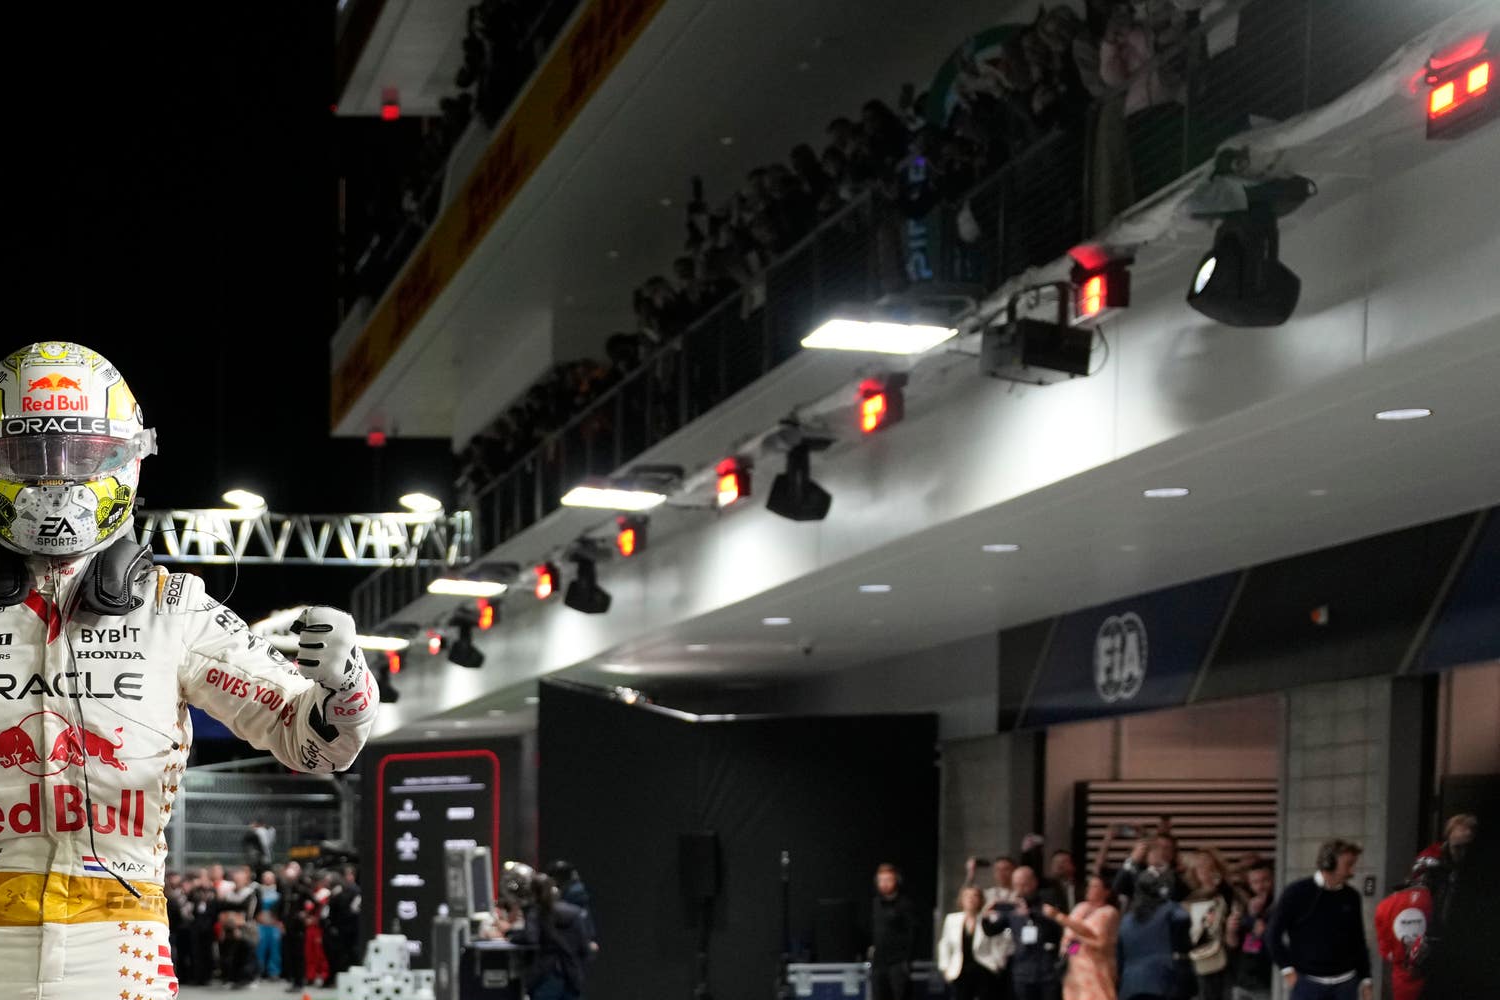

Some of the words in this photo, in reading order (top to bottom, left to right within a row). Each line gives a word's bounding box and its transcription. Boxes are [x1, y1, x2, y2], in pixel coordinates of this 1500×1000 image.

[22, 395, 54, 412] Red
[57, 395, 88, 412] Bull
[6, 418, 107, 436] ORACLE
[38, 517, 77, 536] EA
[37, 536, 78, 547] SPORTS
[82, 625, 141, 643] BYBIT
[76, 651, 146, 660] HONDA
[1099, 622, 1143, 684] FIA
[206, 668, 251, 698] GIVES
[253, 685, 286, 712] YOU
[53, 785, 145, 837] Bull
[112, 861, 146, 873] MAX
